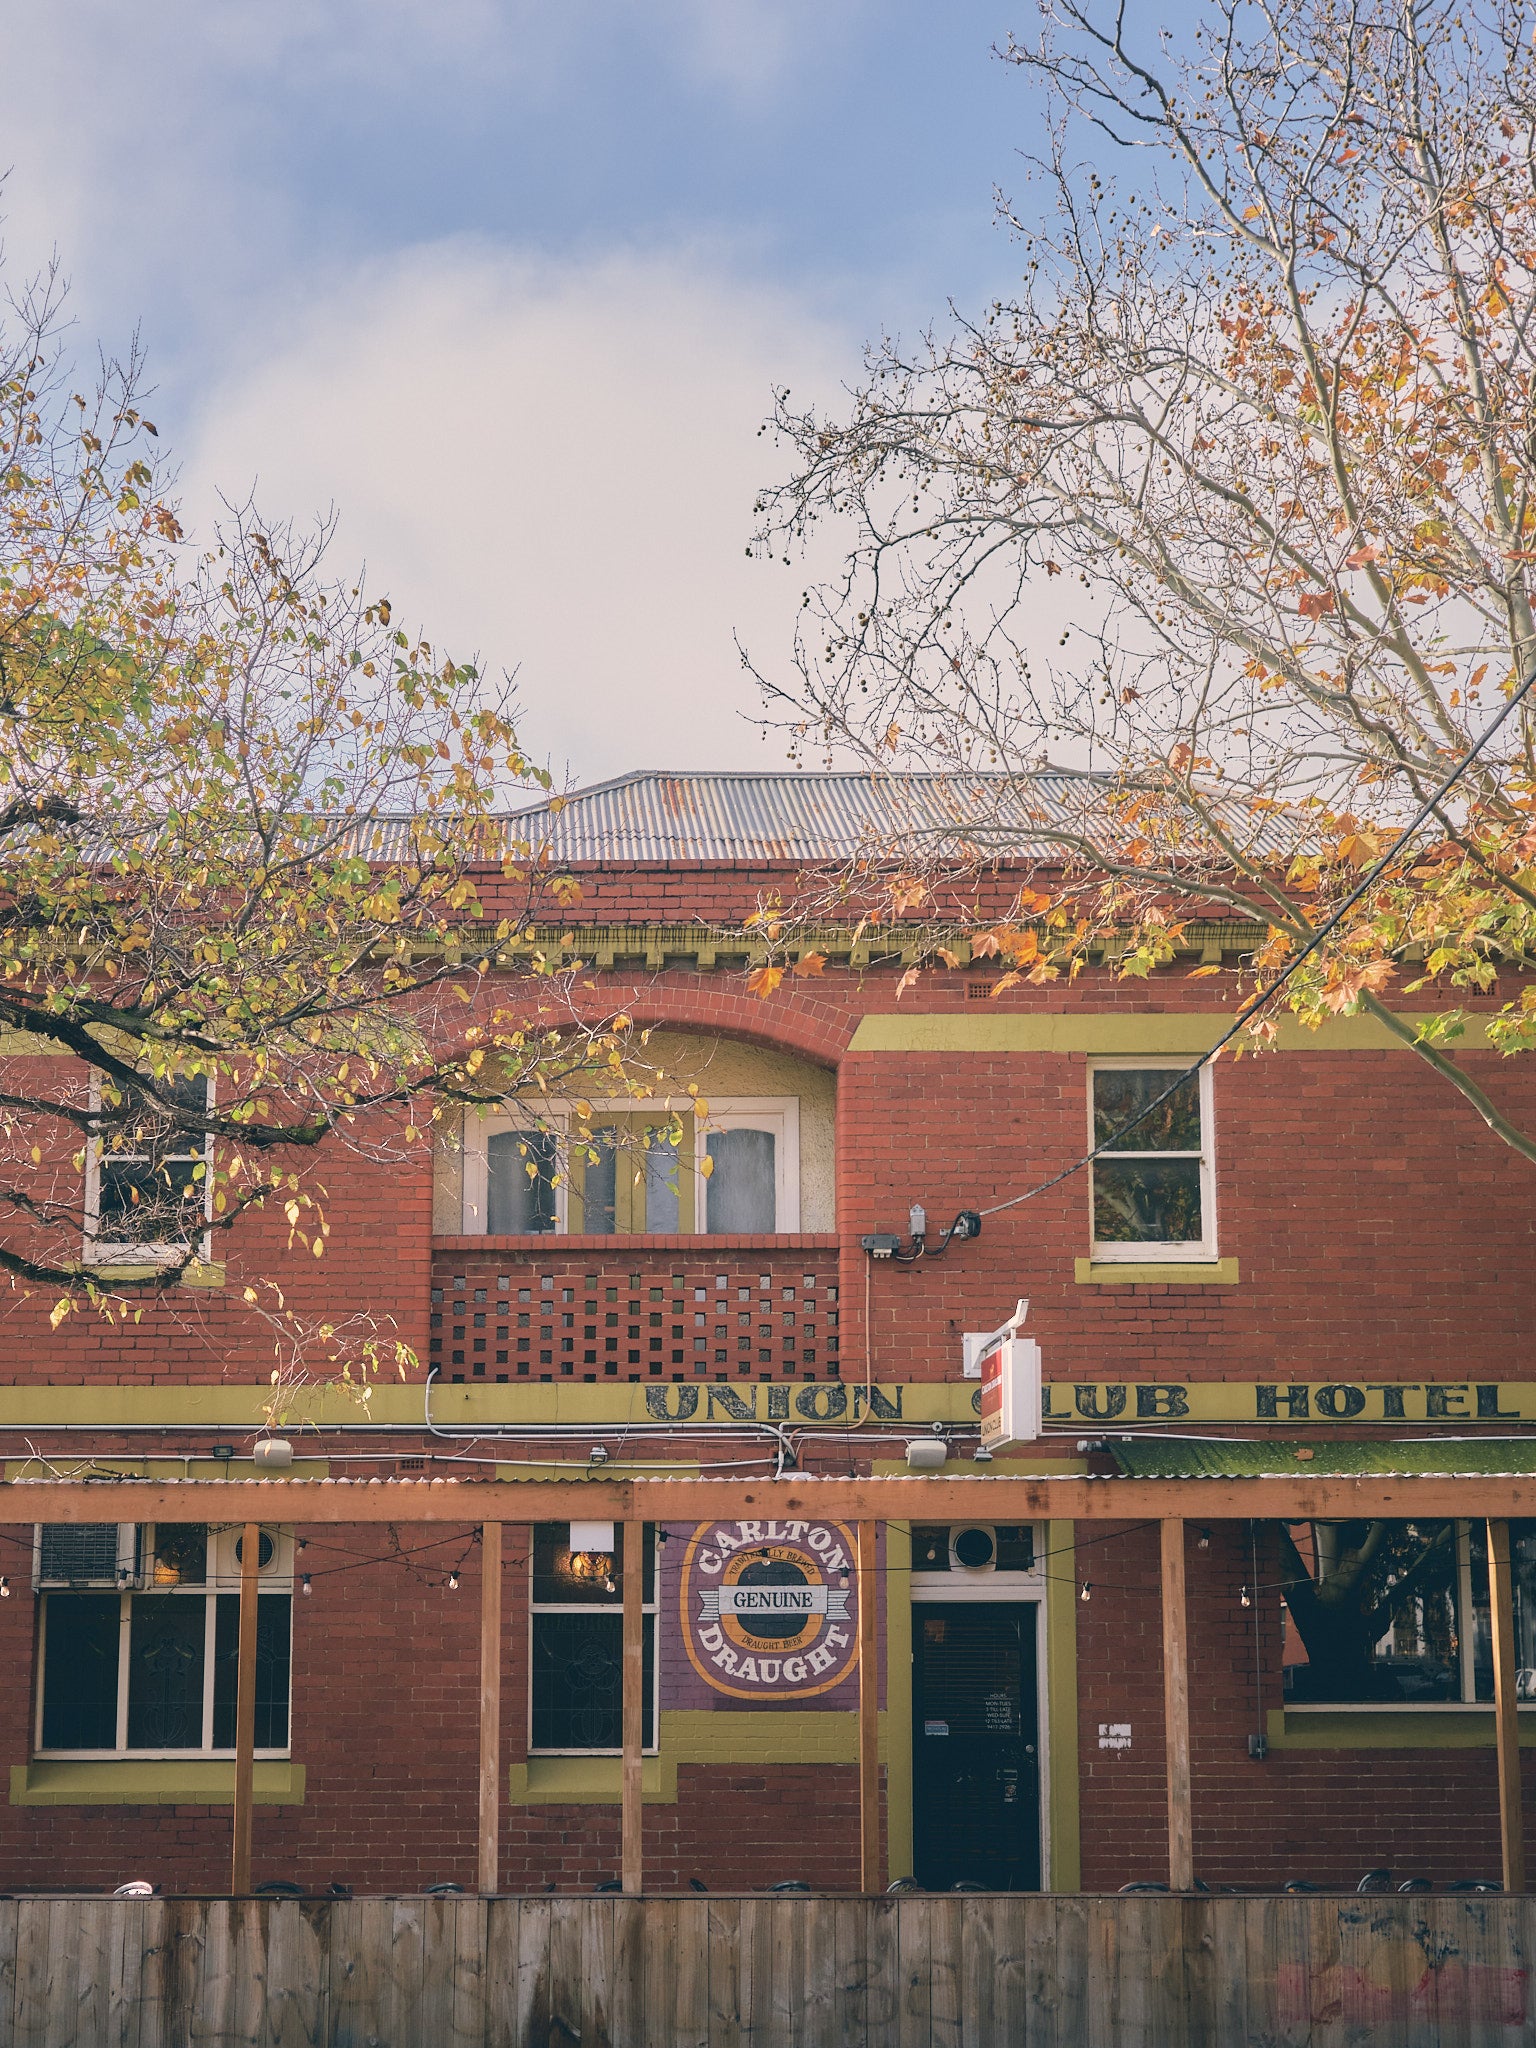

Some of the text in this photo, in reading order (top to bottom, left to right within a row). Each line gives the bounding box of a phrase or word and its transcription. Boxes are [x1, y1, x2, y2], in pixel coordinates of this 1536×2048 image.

[645, 1385, 904, 1420] UNION
[971, 1384, 1190, 1420] LUB
[1255, 1384, 1521, 1418] HOTEL
[698, 1520, 850, 1575] CARLTON
[733, 1591, 813, 1608] GENUINE
[698, 1622, 850, 1683] DRAUGHT
[740, 1634, 803, 1650] DRAUGHT BEER
